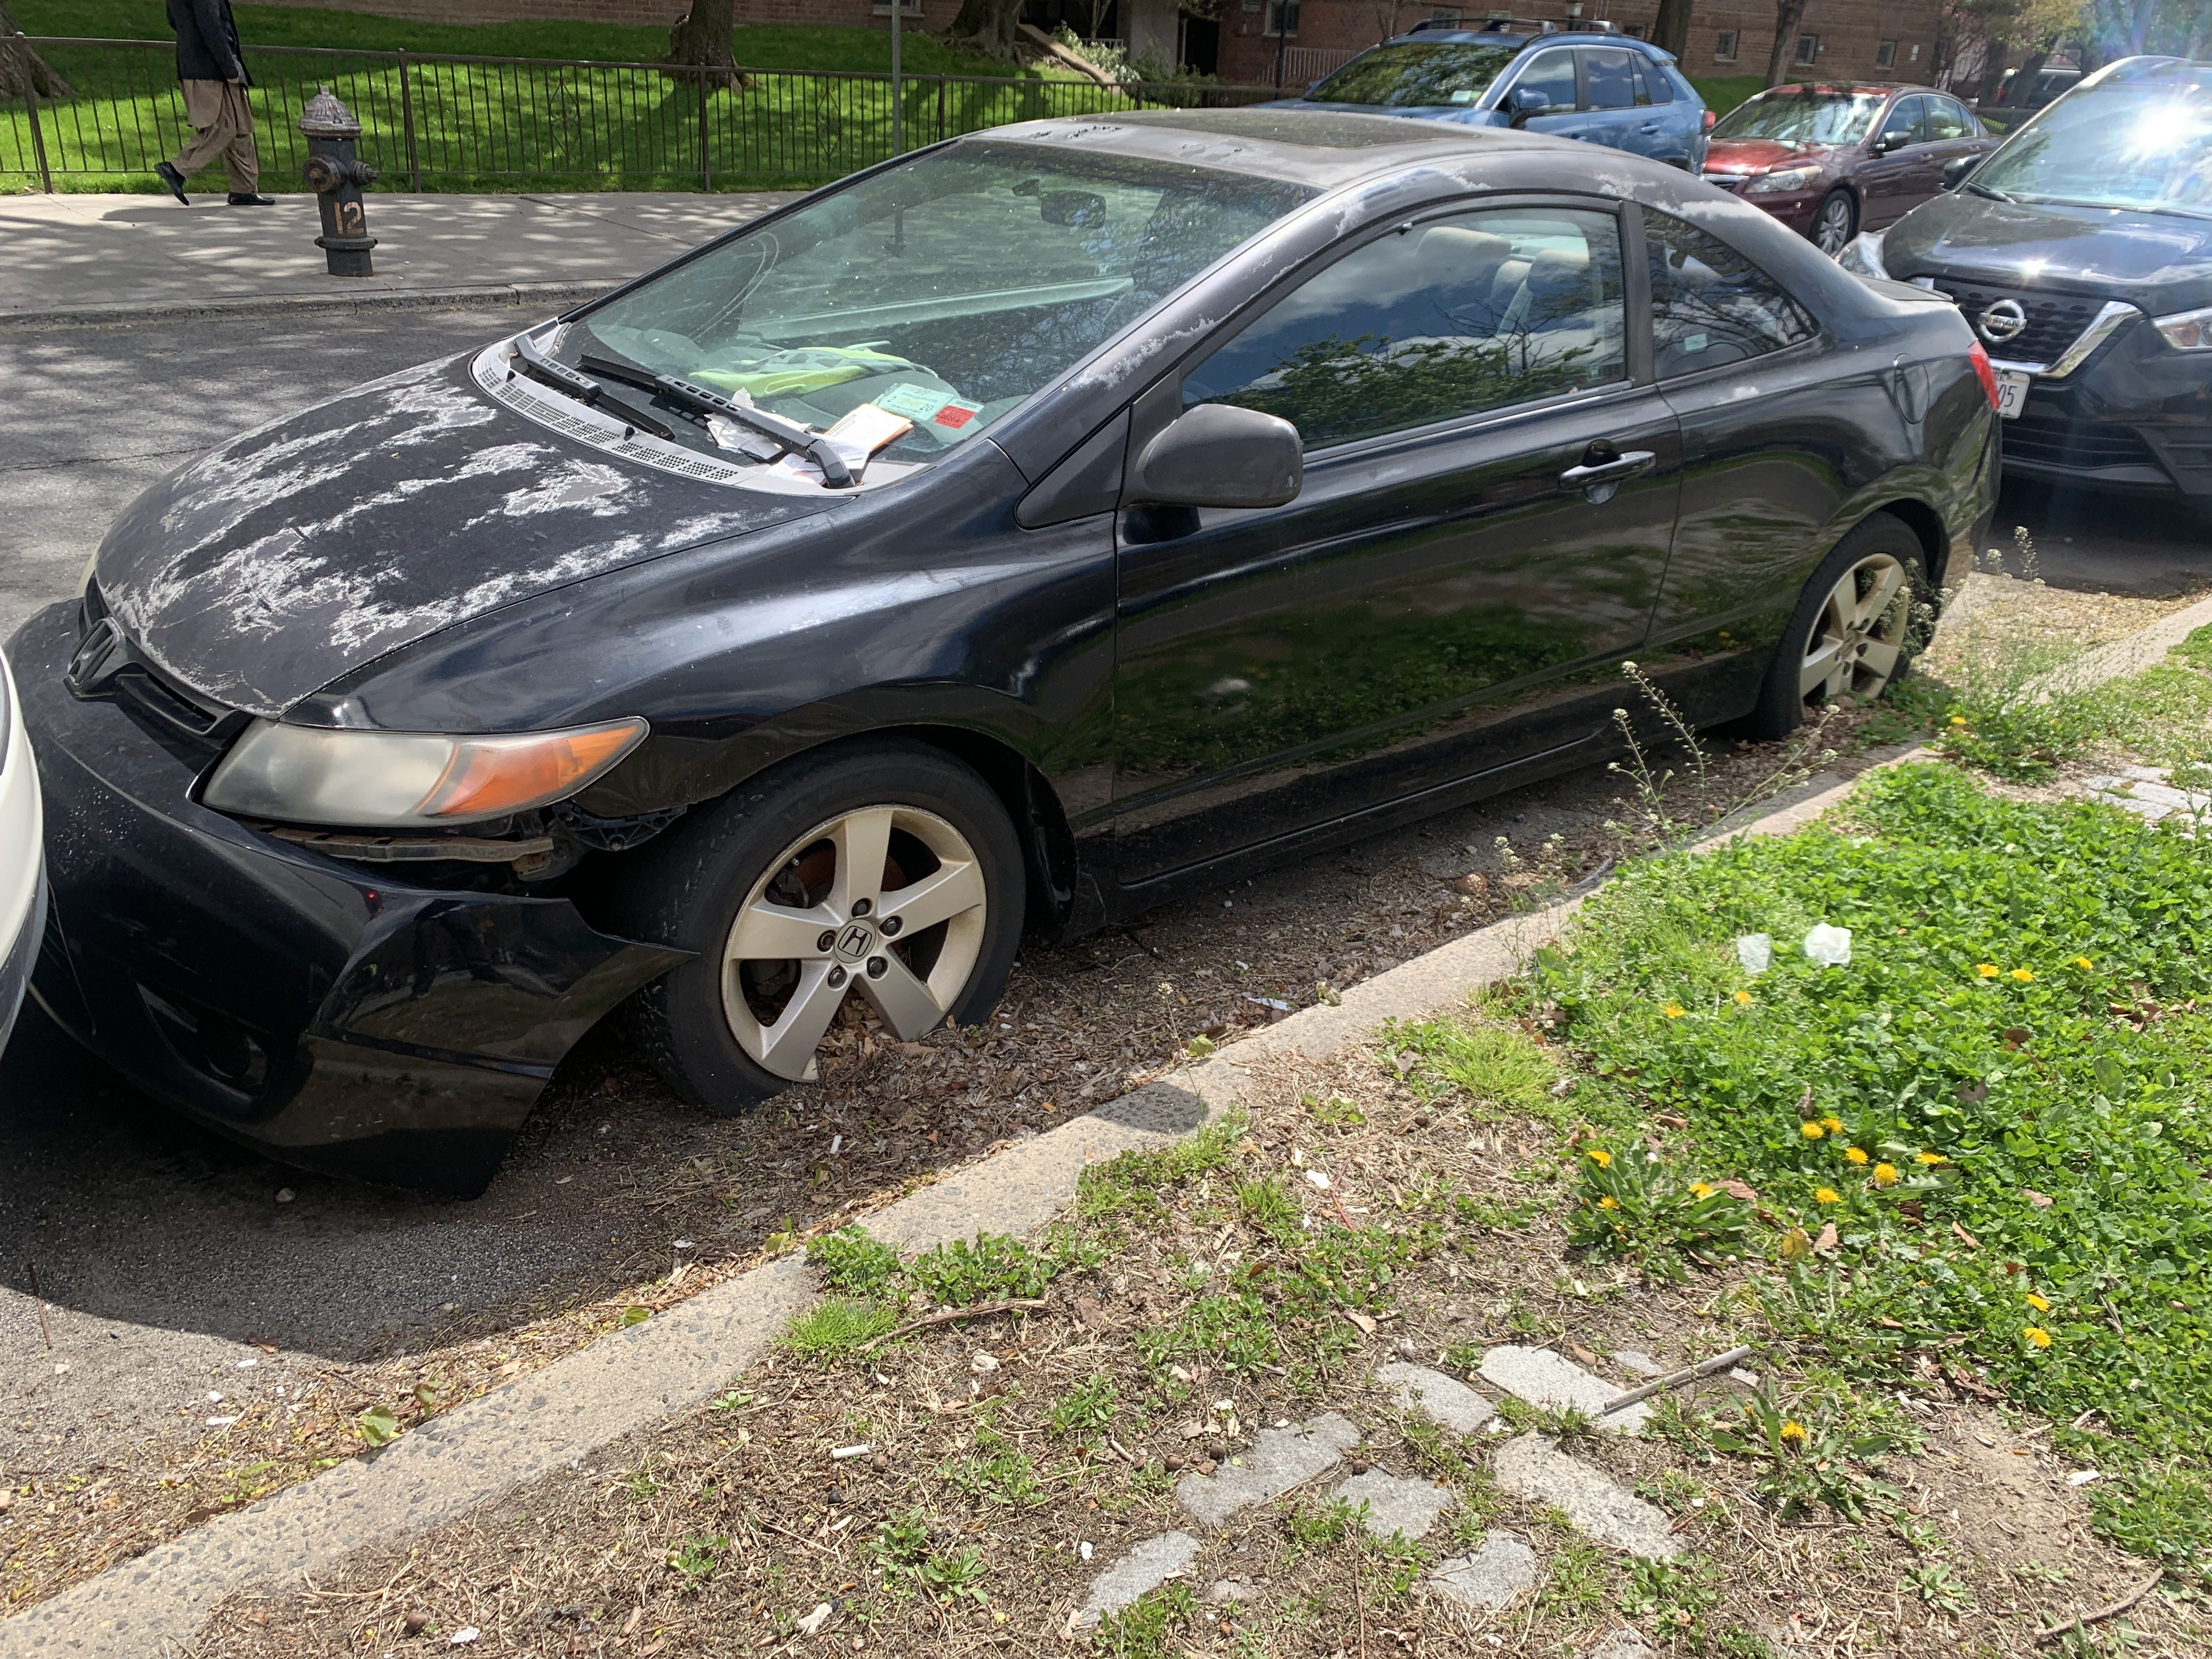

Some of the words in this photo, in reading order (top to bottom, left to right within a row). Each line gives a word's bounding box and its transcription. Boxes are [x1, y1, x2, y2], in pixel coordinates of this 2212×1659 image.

[334, 201, 364, 235] 12
[1982, 317, 2020, 327] NISSAN
[1999, 384, 2018, 407] 05
[919, 403, 934, 412] 20
